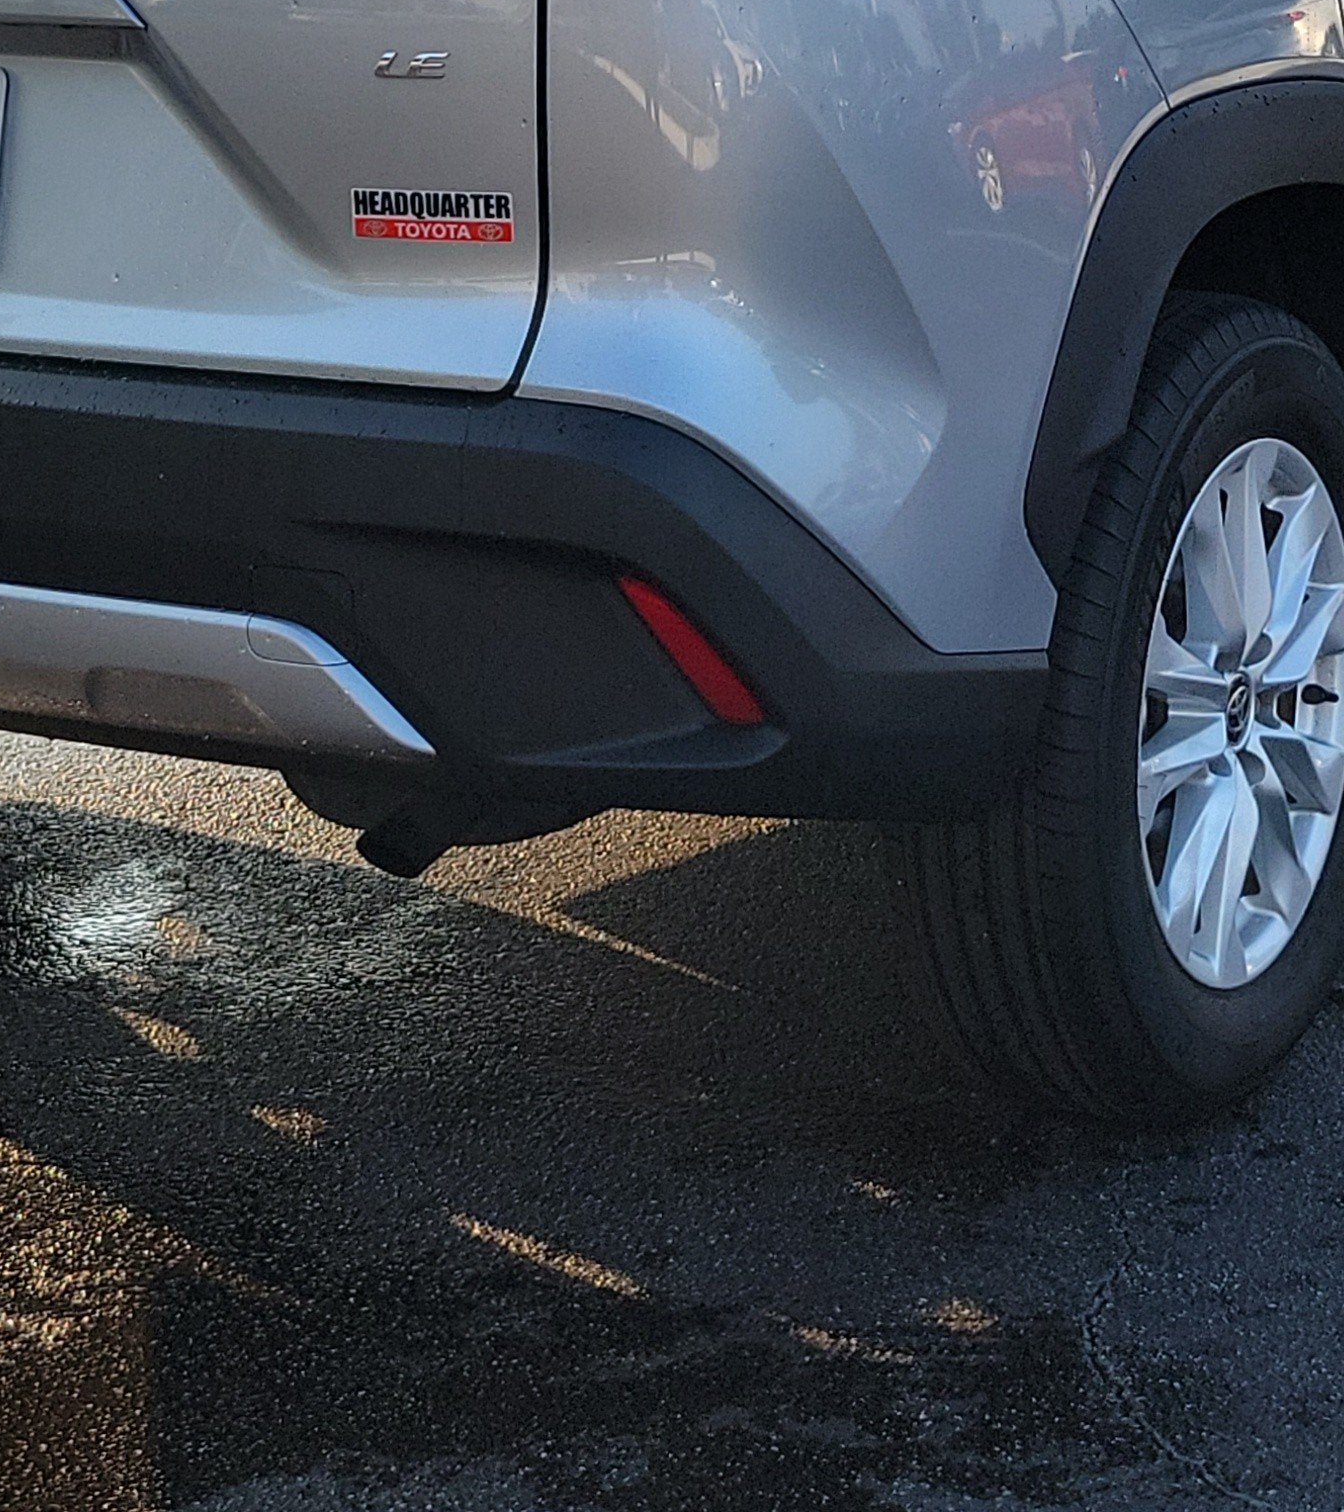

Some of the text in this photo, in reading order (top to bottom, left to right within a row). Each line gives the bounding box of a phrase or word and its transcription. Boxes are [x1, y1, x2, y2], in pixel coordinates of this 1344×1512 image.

[374, 49, 451, 79] LE
[355, 190, 511, 219] HEADQUARTER
[394, 222, 472, 239] TOYOTA
